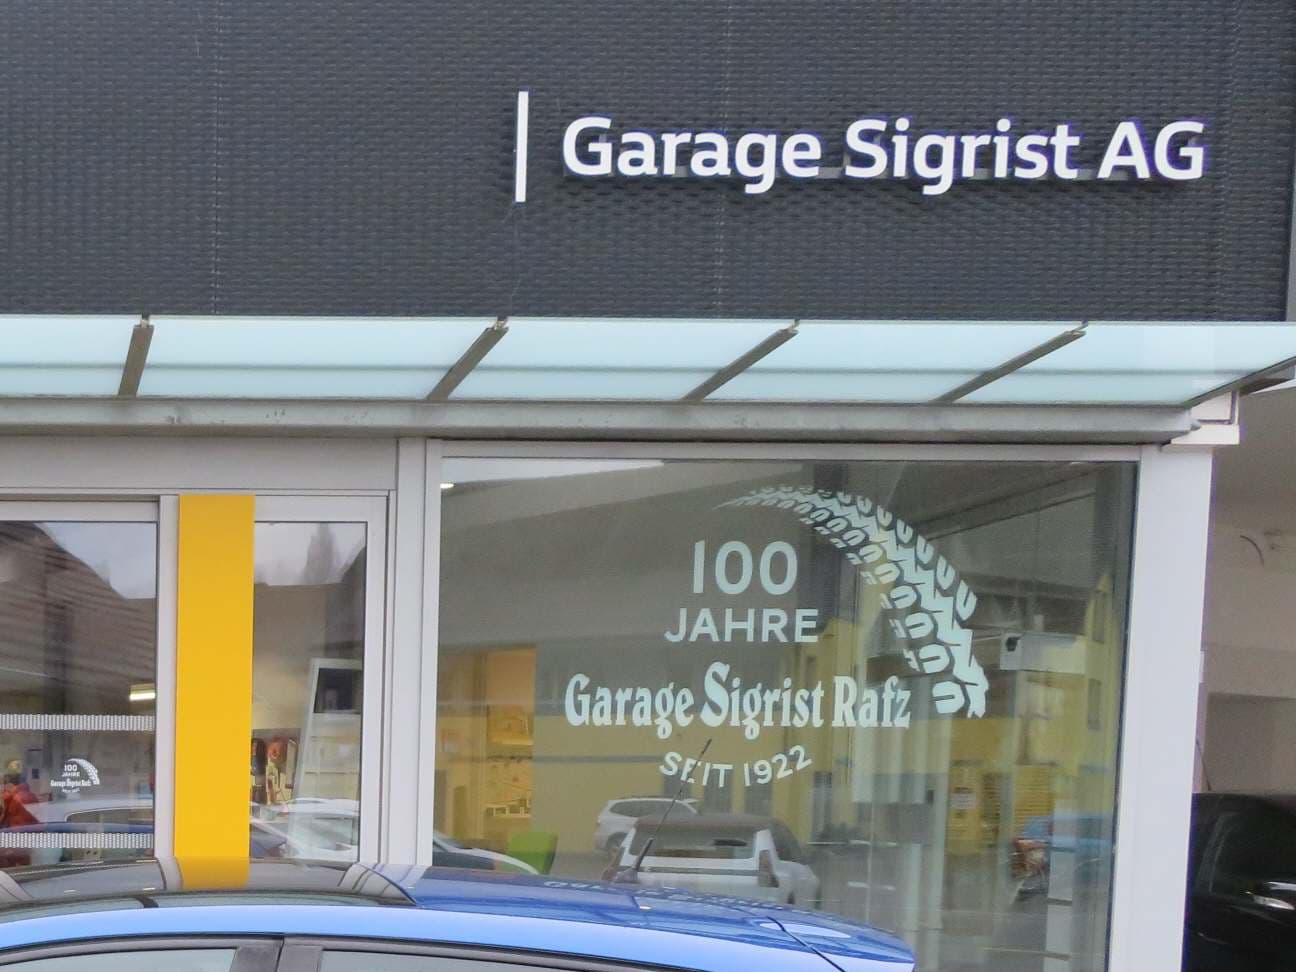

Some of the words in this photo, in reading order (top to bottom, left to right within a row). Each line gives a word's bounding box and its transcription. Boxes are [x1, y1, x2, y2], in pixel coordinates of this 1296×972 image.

[562, 116, 823, 194] Garage
[844, 117, 1080, 195] Sigrist
[1097, 121, 1205, 181] AG
[693, 539, 798, 595] 100
[664, 607, 818, 643] JAHRE
[565, 673, 694, 739] Garage
[700, 661, 824, 740] Sigrist
[832, 675, 912, 729] Rafz
[659, 752, 734, 788] SEIT
[744, 745, 813, 787] 1922
